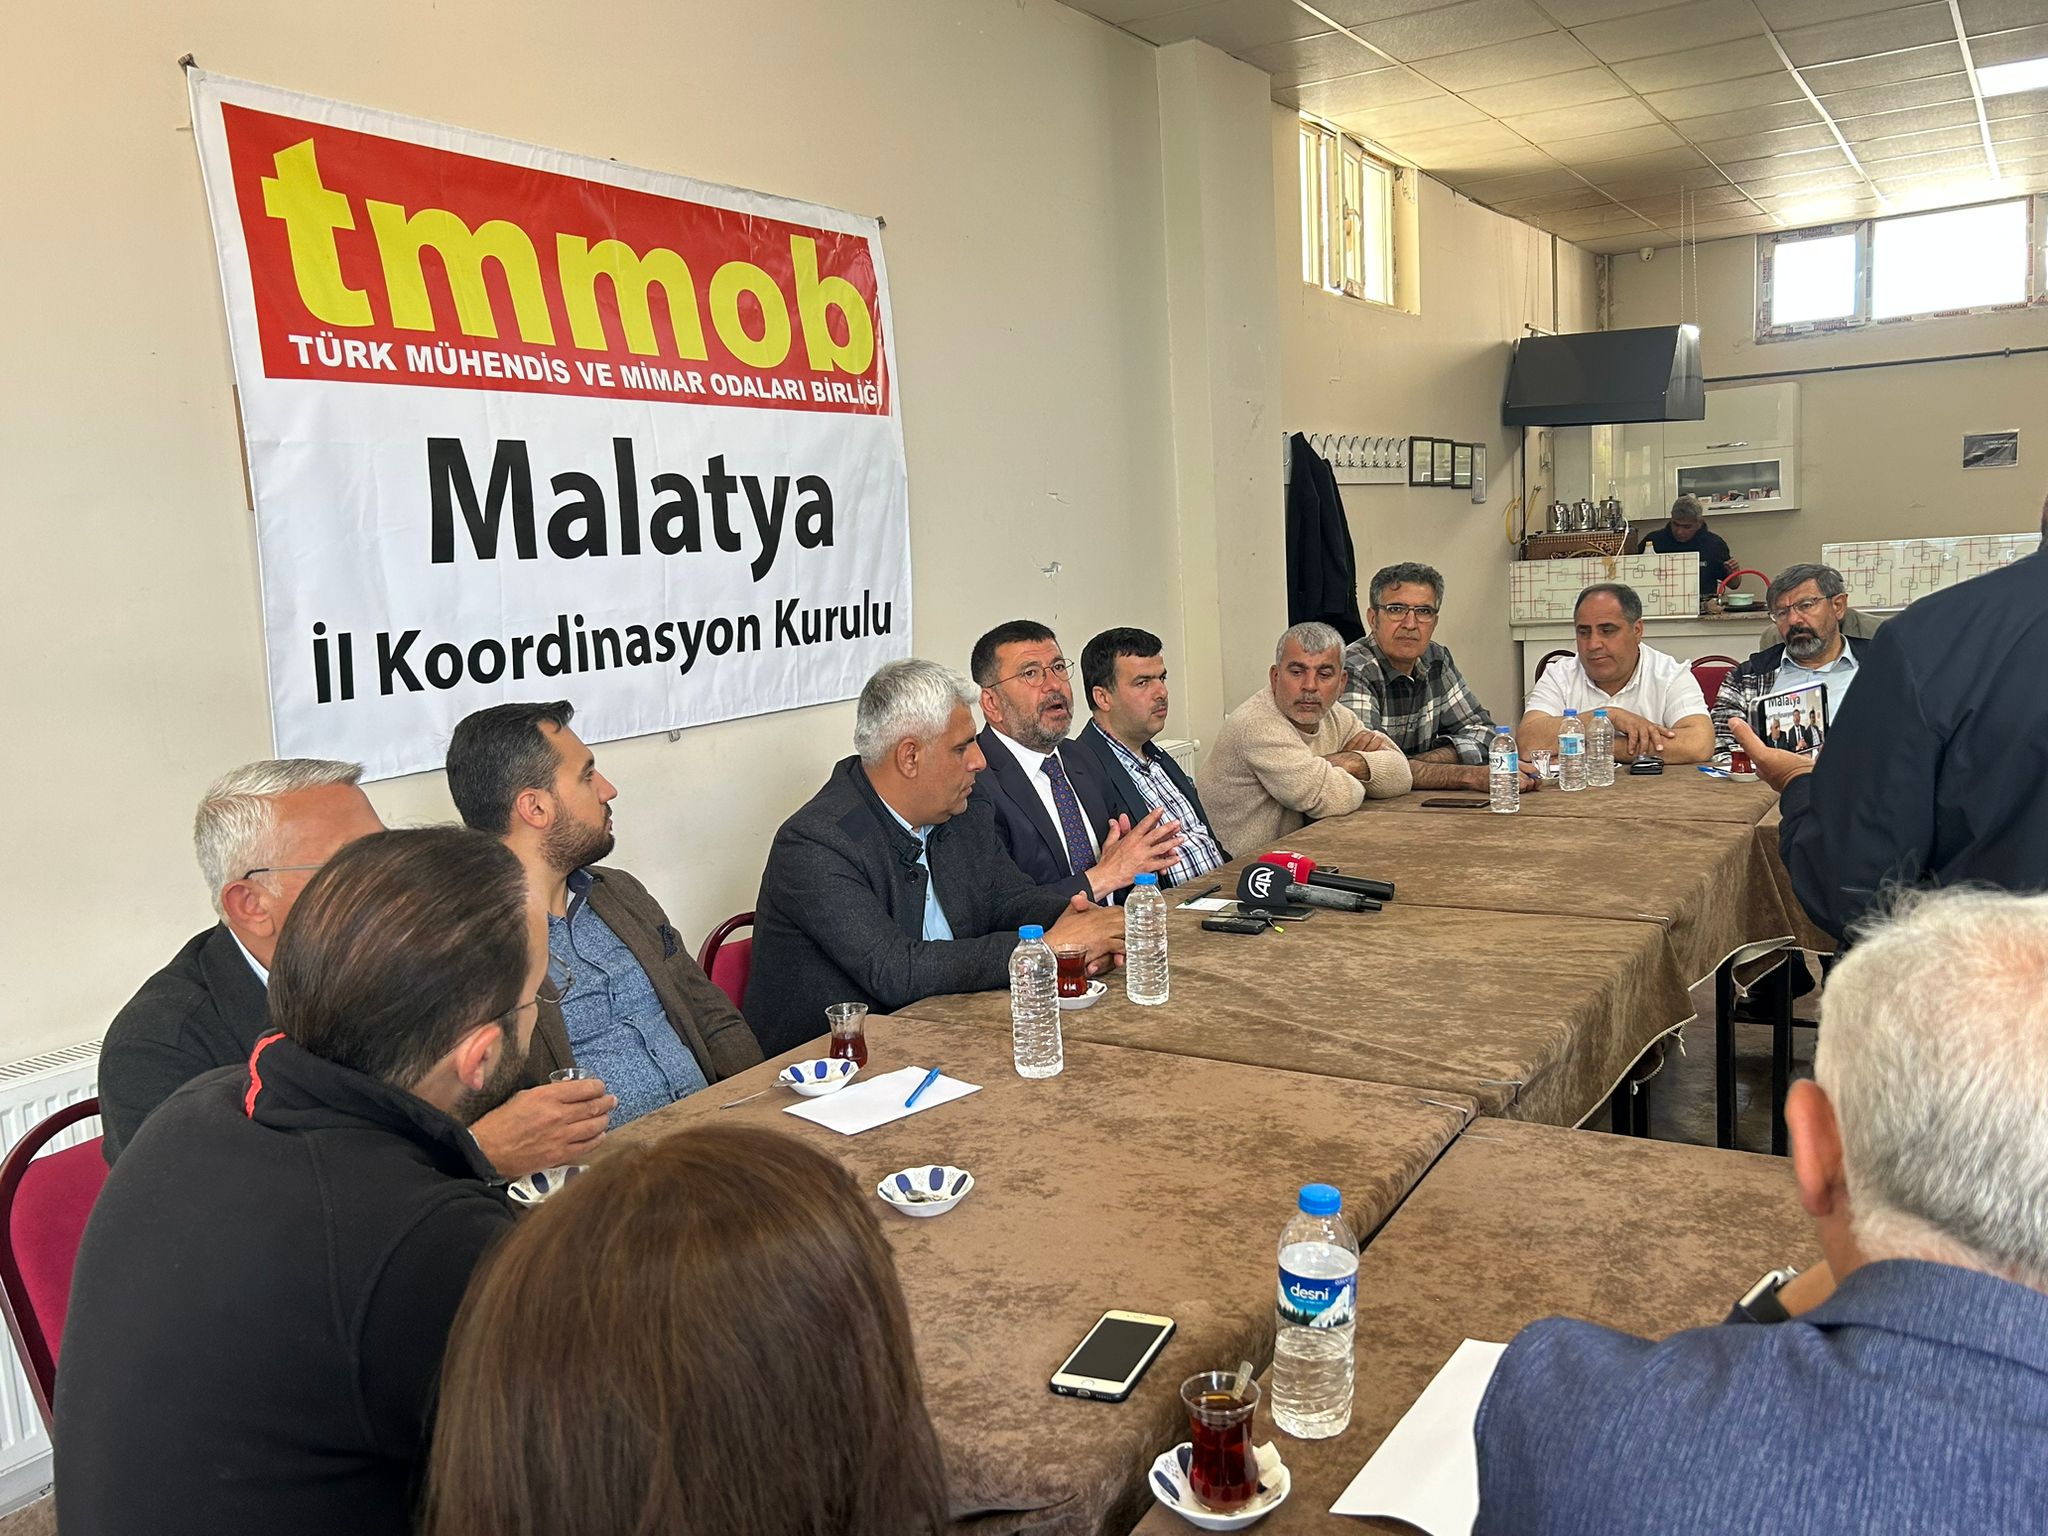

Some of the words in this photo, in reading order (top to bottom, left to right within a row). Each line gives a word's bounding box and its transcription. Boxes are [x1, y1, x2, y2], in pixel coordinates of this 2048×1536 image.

[261, 138, 875, 374] tmmob
[288, 331, 398, 371] TÜRK
[405, 341, 571, 384] MÜHENDİS
[575, 361, 615, 388] VE
[619, 361, 706, 395] MİMAR
[710, 373, 807, 402] ODALARI
[426, 437, 834, 582] Malatya
[312, 621, 356, 704] İl
[375, 611, 761, 695] Koordinasyon
[774, 589, 893, 649] Kurulu
[1290, 1282, 1329, 1301] desni
